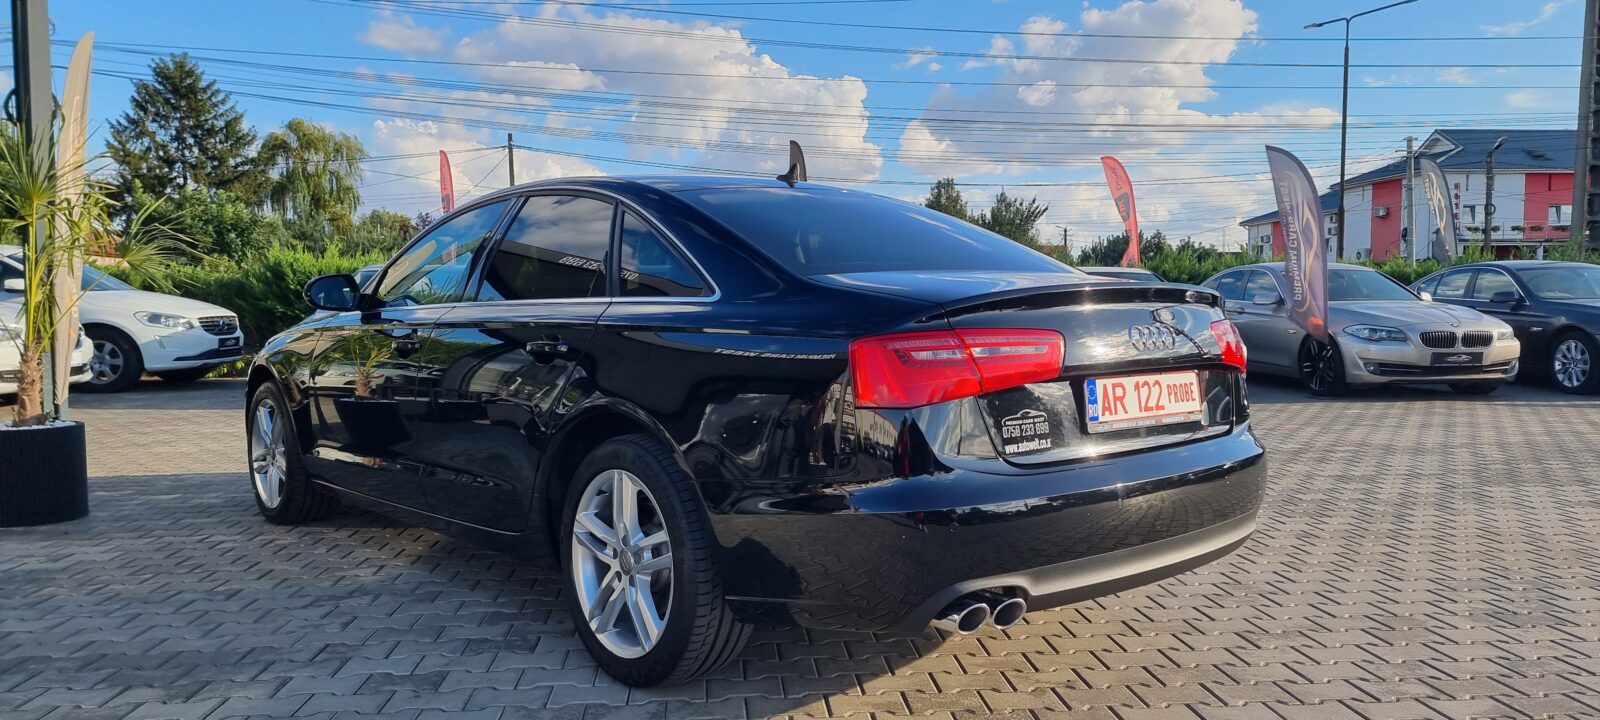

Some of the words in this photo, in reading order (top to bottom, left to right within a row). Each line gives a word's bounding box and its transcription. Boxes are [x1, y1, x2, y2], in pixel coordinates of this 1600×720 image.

[1101, 382, 1128, 416] AR
[1134, 380, 1165, 413] 122
[1166, 382, 1196, 404] PROBE
[1088, 404, 1098, 417] RO
[1002, 425, 1021, 438] 0758
[1021, 423, 1035, 436] 233
[1035, 421, 1050, 434] 699
